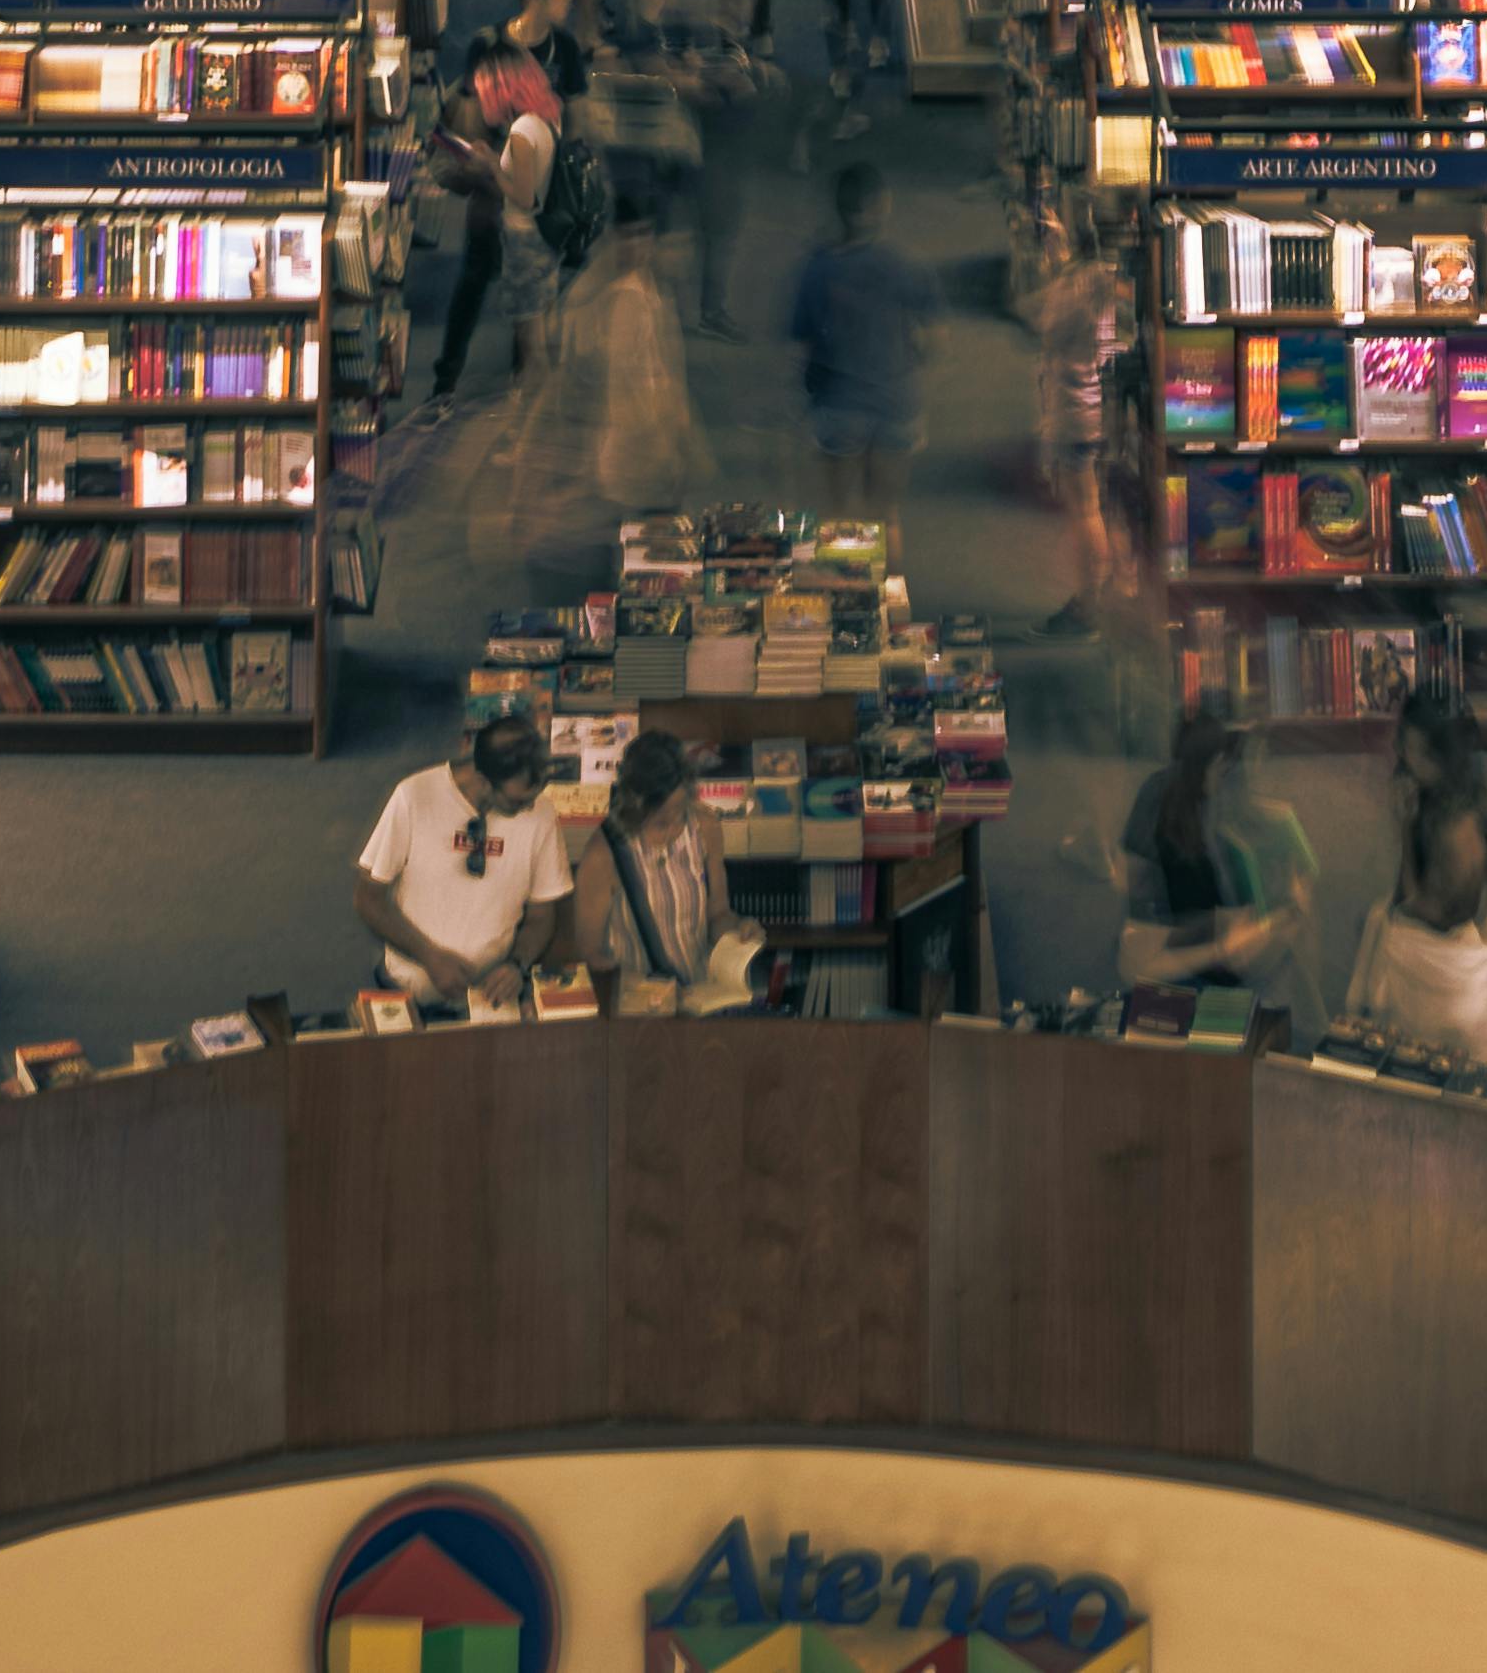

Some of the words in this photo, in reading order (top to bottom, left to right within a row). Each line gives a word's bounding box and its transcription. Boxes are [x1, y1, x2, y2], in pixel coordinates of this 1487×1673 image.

[108, 157, 285, 178] ANTROPOLOGIA
[1243, 158, 1298, 179] ARTE
[1304, 158, 1438, 179] ARGENTINO
[651, 1514, 1131, 1653] Ateneo
